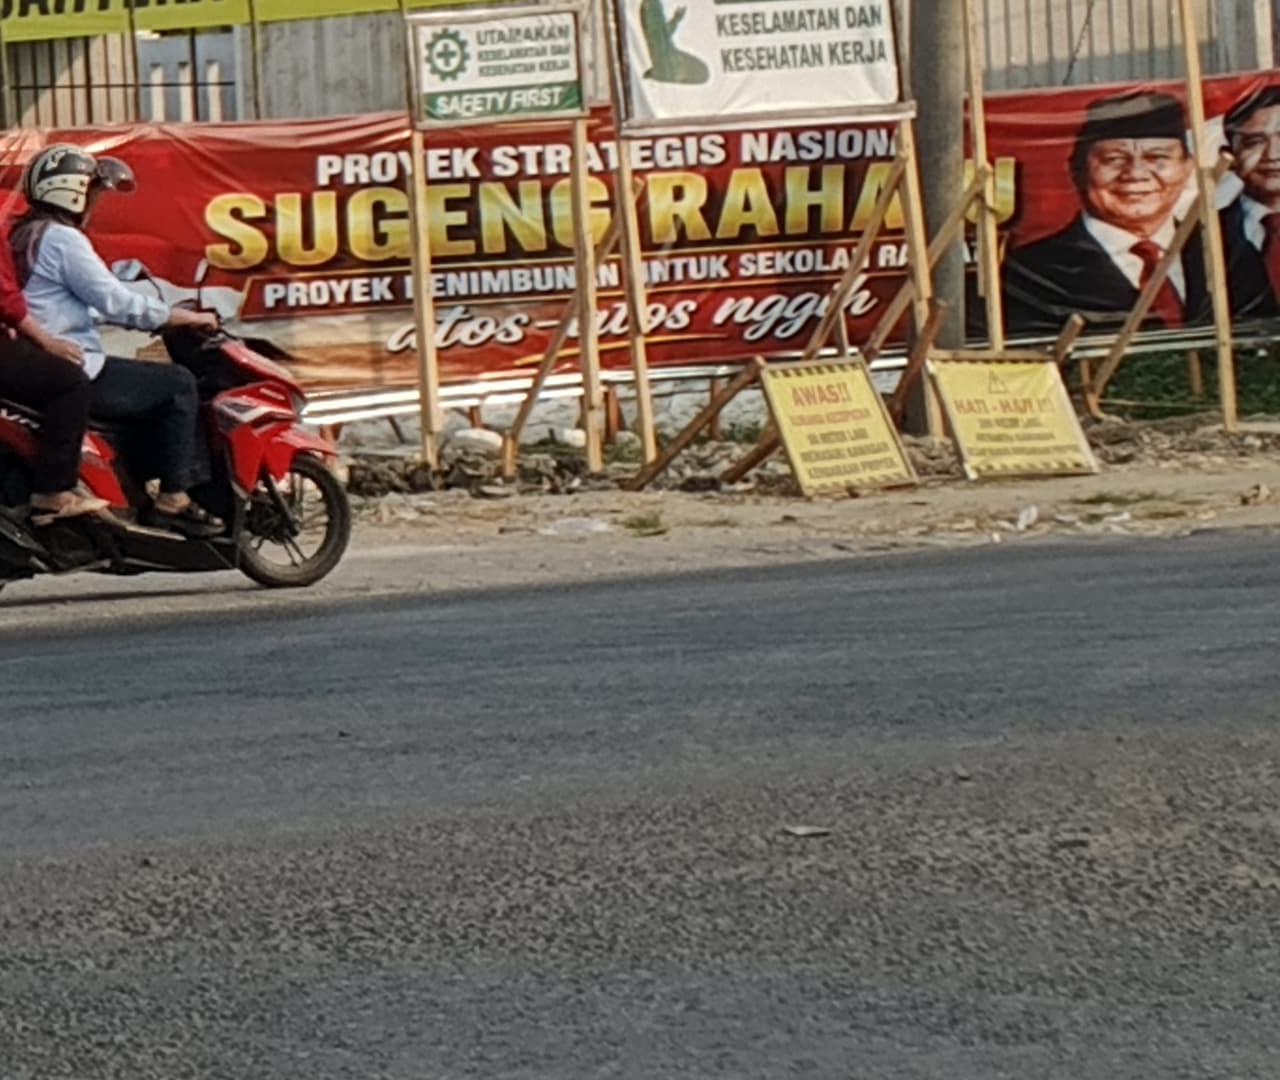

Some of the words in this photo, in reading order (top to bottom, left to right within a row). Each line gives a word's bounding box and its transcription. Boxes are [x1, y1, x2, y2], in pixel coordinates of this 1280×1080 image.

[716, 8, 840, 36] KESELAMATAN
[846, 5, 882, 29] DAN
[721, 43, 824, 73] KESEHATAN
[829, 39, 887, 65] KERJA
[435, 91, 508, 117] SAFETY
[510, 86, 563, 110] FIRST
[264, 276, 394, 308] PROYEK
